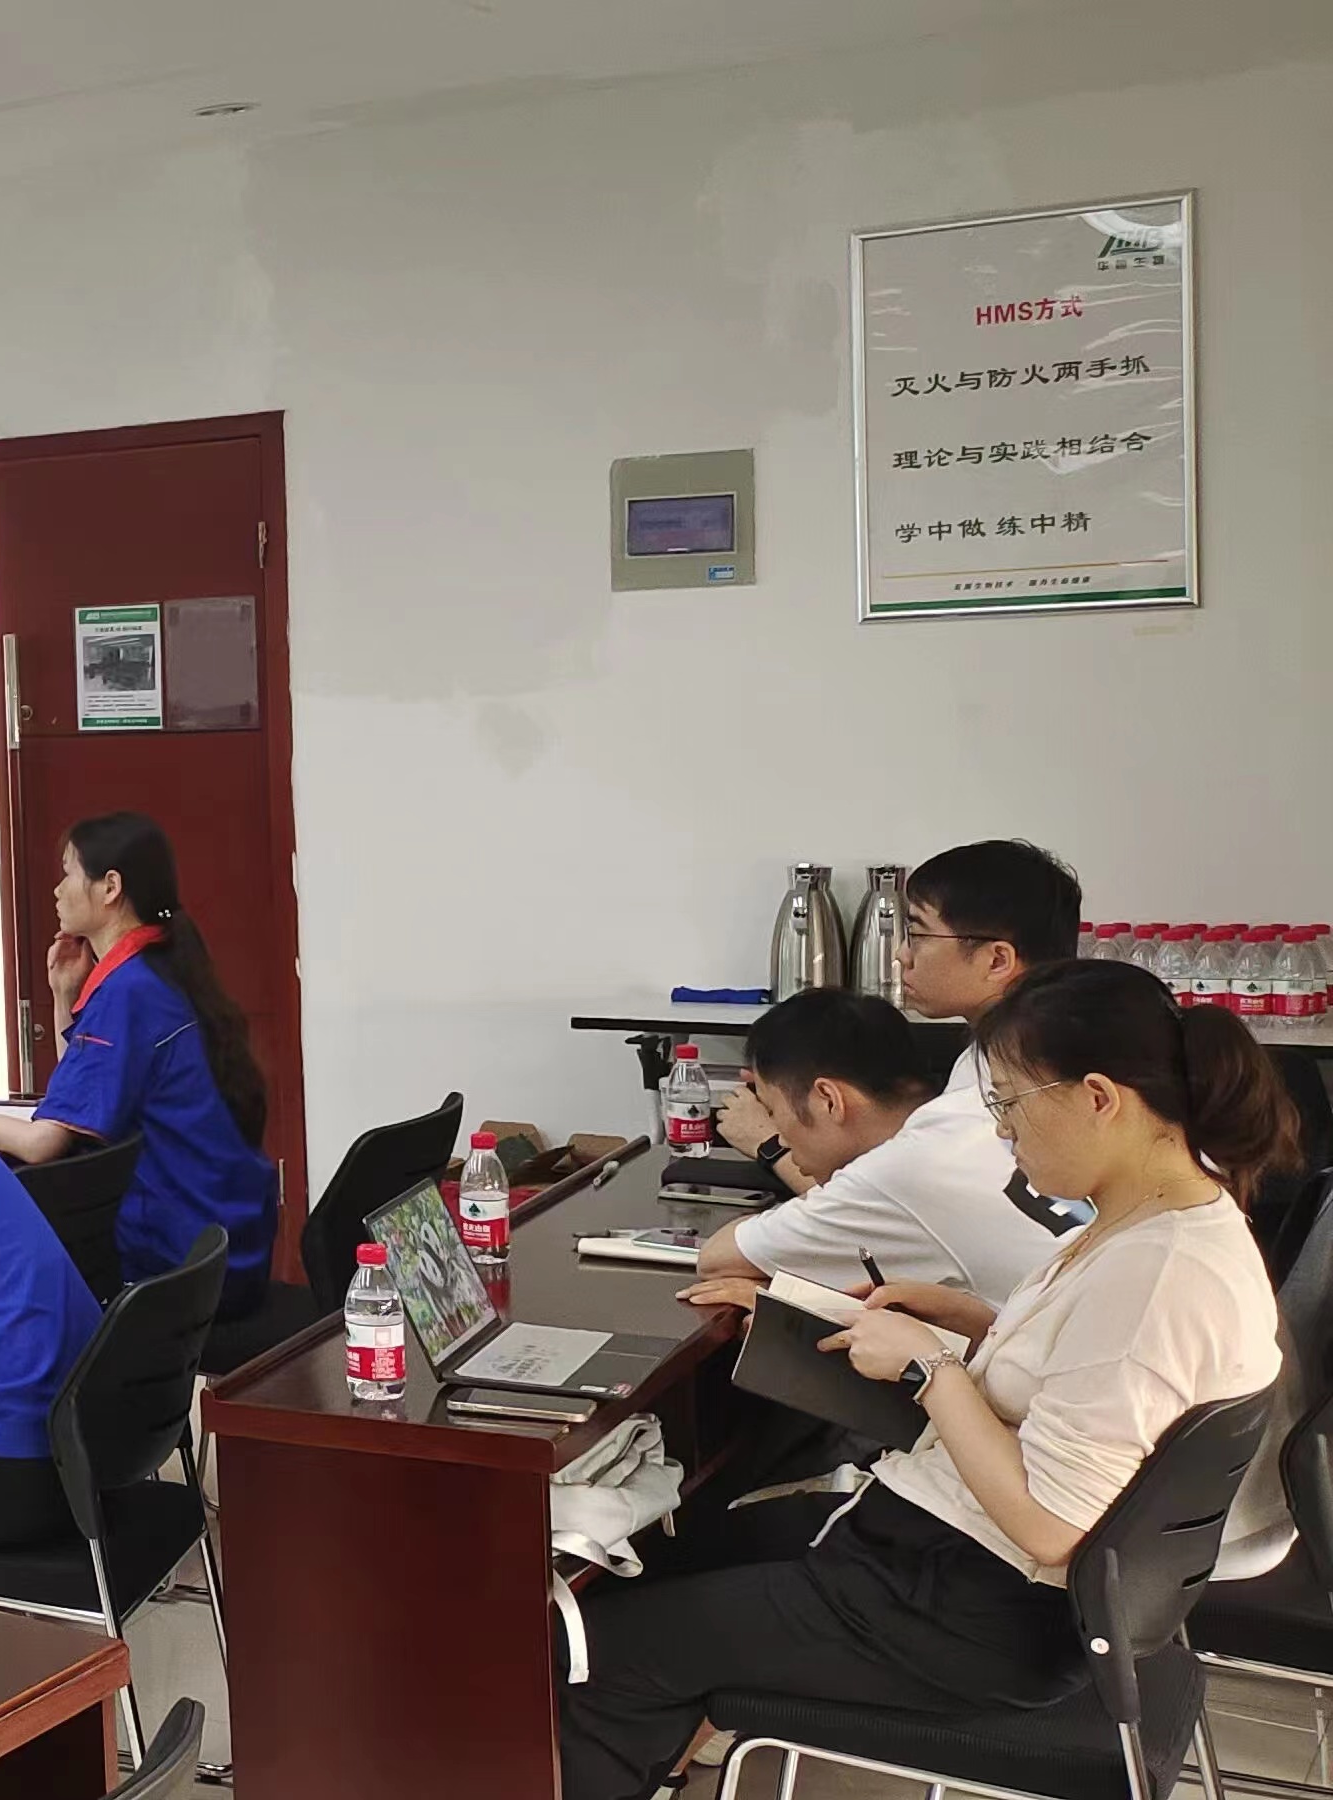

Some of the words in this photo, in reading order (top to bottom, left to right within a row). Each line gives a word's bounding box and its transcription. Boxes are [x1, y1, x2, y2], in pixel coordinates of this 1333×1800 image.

[976, 296, 1083, 326] HMS方式
[891, 355, 1151, 397] 灭火与防火两手抓
[892, 432, 1152, 470] 理论与实践相结合
[895, 517, 987, 543] 学中做
[995, 511, 1092, 537] 练中精
